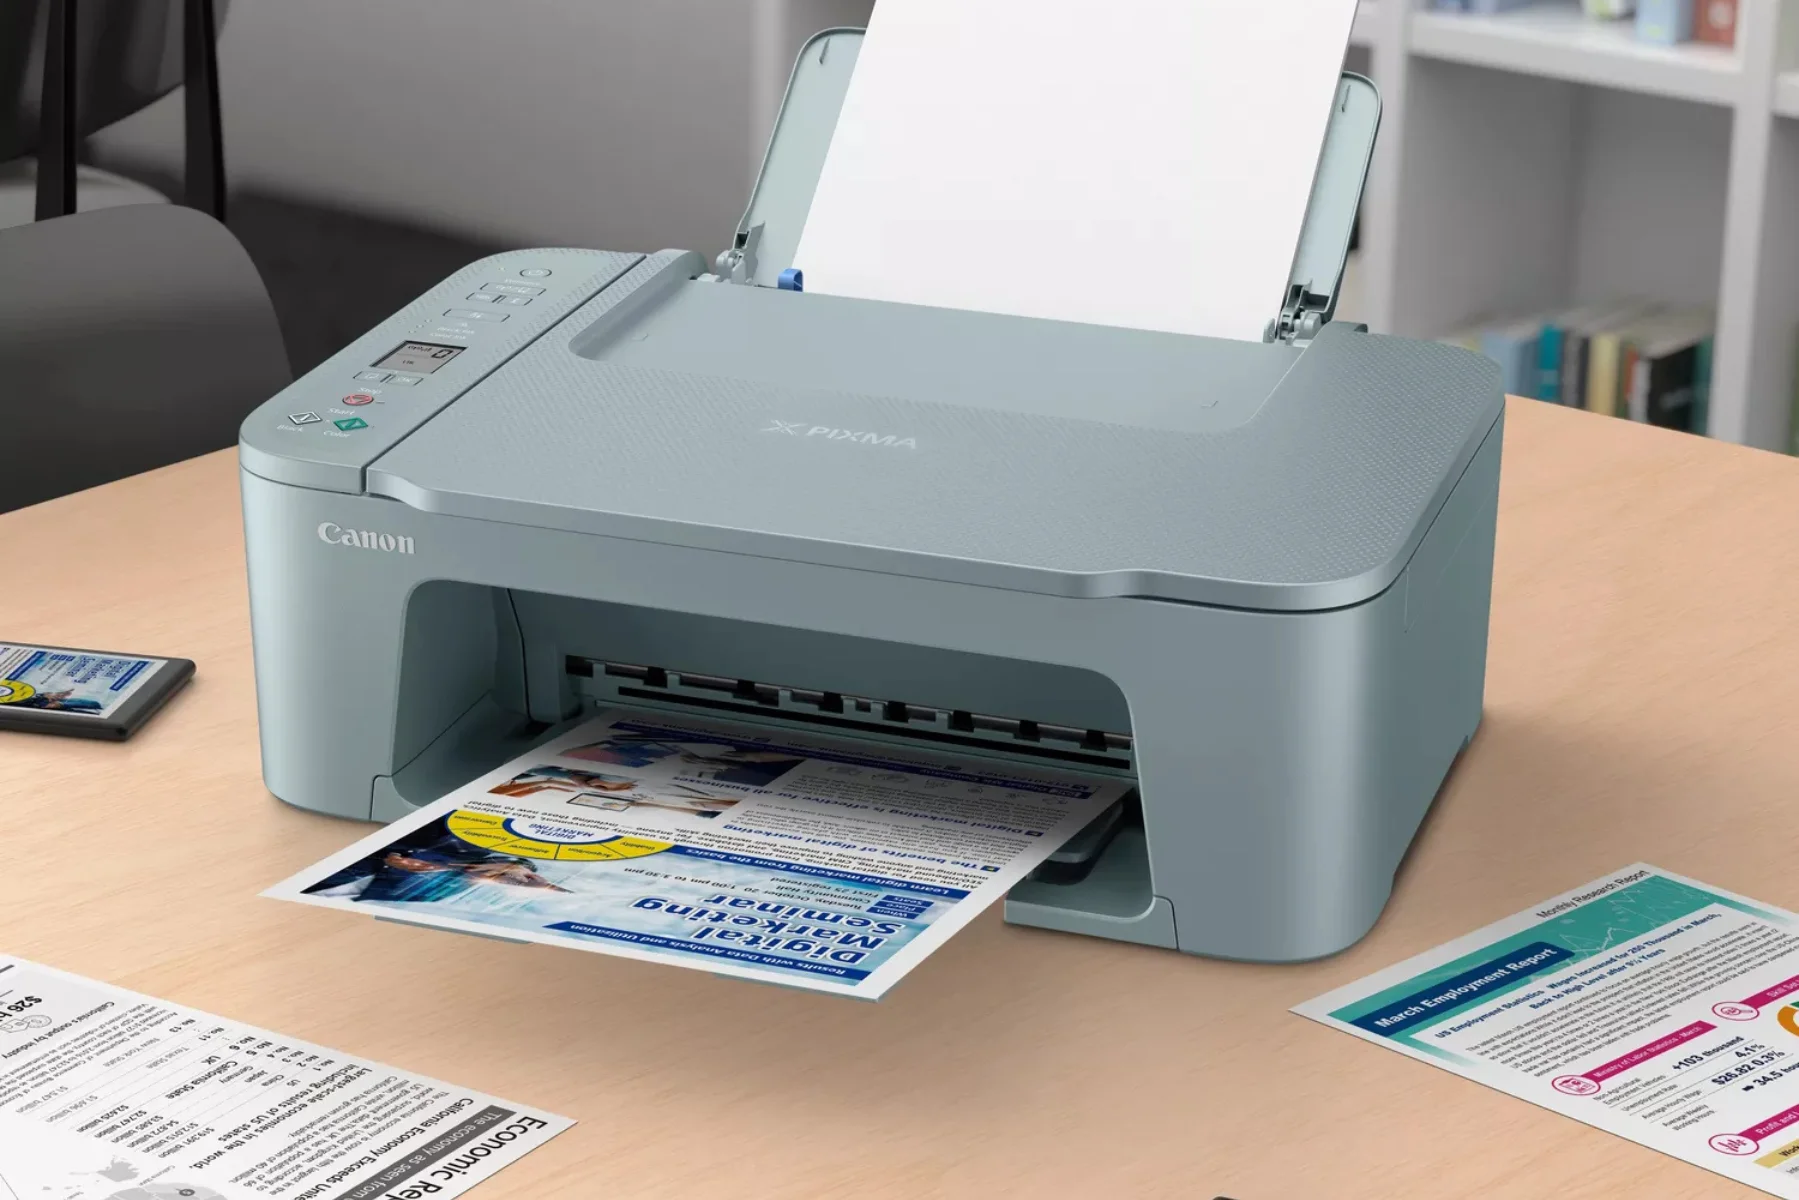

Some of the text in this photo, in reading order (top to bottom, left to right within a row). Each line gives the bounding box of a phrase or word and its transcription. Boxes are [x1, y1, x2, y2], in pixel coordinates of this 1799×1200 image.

[805, 426, 916, 450] PIXMA
[318, 521, 415, 555] Canon
[673, 776, 750, 792] businesses
[803, 796, 868, 809] effective
[889, 809, 967, 824] marketing
[529, 823, 593, 837] MARKETING
[535, 829, 576, 839] DIGITAL
[723, 824, 801, 840] marketing
[971, 822, 1022, 833] Digital
[805, 838, 856, 849] digital
[687, 849, 726, 859] basics
[882, 850, 946, 863] benefits
[754, 859, 787, 868] from
[790, 865, 860, 879] marketing
[770, 877, 831, 889] registered
[862, 877, 907, 887] digital
[910, 884, 949, 894] Learn
[764, 890, 810, 901] October
[804, 889, 870, 903] Community
[852, 890, 878, 898] First
[1536, 870, 1649, 918] Monthly Research Report
[815, 898, 861, 910] Tuesday,
[886, 902, 916, 911] Place
[707, 896, 898, 933] Seminar
[877, 907, 907, 917] When
[636, 898, 880, 948] Marketing
[670, 941, 724, 954] Analysis
[696, 928, 863, 962] Digital
[727, 951, 759, 960] Data
[762, 957, 793, 965] with
[797, 963, 845, 974] Results
[1435, 1030, 1451, 1038] US
[1450, 1007, 1504, 1032] Employment
[1502, 990, 1544, 1009] Statistics
[1546, 976, 1577, 989] Wages
[1575, 957, 1617, 976] Increased
[1643, 928, 1684, 946] Thousand
[1690, 914, 1721, 926] March,
[1529, 998, 1553, 1009] Back
[1561, 984, 1584, 994] High
[1581, 973, 1607, 986] Level
[1606, 965, 1627, 976] after
[1638, 948, 1665, 960] Years
[1375, 949, 1556, 1027] March Employment Report
[7, 996, 42, 1012] $26
[71, 1001, 114, 1023] California's
[45, 1022, 72, 1037] output
[33, 1035, 48, 1043] by
[236, 1036, 256, 1044] No.
[254, 1041, 273, 1049] No.
[1, 1042, 36, 1058] industry
[1593, 1064, 1623, 1077] Ministry
[1627, 1051, 1648, 1061] Labor
[1679, 1026, 1701, 1037] March
[1673, 1036, 1744, 1069] +103 thousand
[1735, 1044, 1764, 1057] 4.1%
[202, 1055, 220, 1065] UK
[219, 1066, 253, 1083] Germany
[1712, 1051, 1784, 1084] $26.82 0.3%
[165, 1061, 237, 1099] California State
[244, 1070, 267, 1082] Japan
[261, 1074, 284, 1086] China
[1753, 1071, 1783, 1085] 34.5
[308, 1068, 371, 1103] Largest-scale
[218, 1064, 357, 1141] including results of US states
[254, 1103, 307, 1132] economies
[420, 1098, 473, 1127] California
[77, 1119, 103, 1132] billion
[1755, 1113, 1796, 1134] Profit and
[94, 1124, 121, 1138] billion
[111, 1129, 137, 1143] billion
[127, 1134, 153, 1147] billion
[142, 1139, 168, 1153] billion
[224, 1140, 245, 1150] the
[371, 1127, 425, 1156] Economy
[158, 1144, 184, 1158] billion
[353, 1112, 501, 1198] The economy as seen from
[432, 1117, 545, 1179] Economic
[189, 1150, 225, 1169] world,
[326, 1156, 376, 1183] Exceeds
